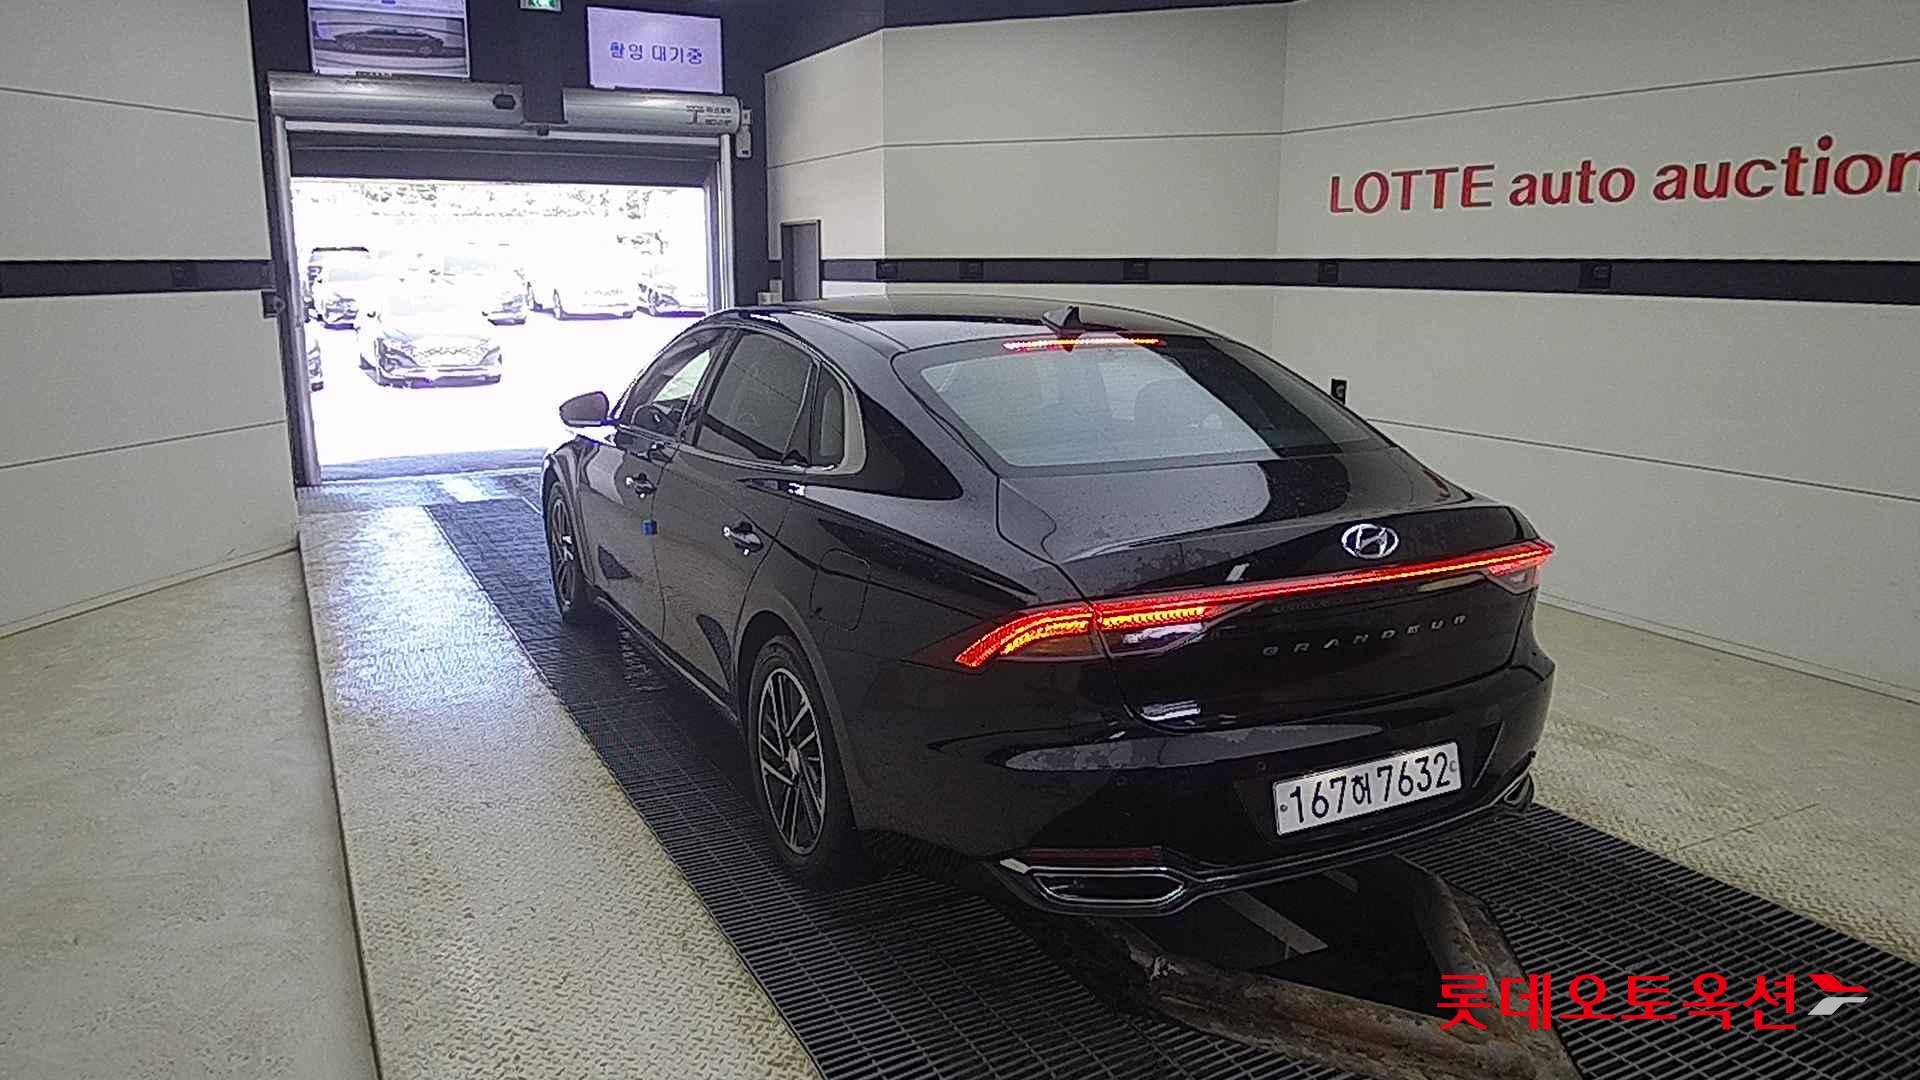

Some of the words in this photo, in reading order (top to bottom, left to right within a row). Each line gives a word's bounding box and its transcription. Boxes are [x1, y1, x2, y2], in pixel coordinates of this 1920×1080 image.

[652, 45, 703, 65] 대기중
[1330, 164, 1495, 214] LOTTE
[1509, 159, 1635, 207] auto
[1652, 134, 1920, 201] auction
[1263, 614, 1466, 656] GRANDEUR
